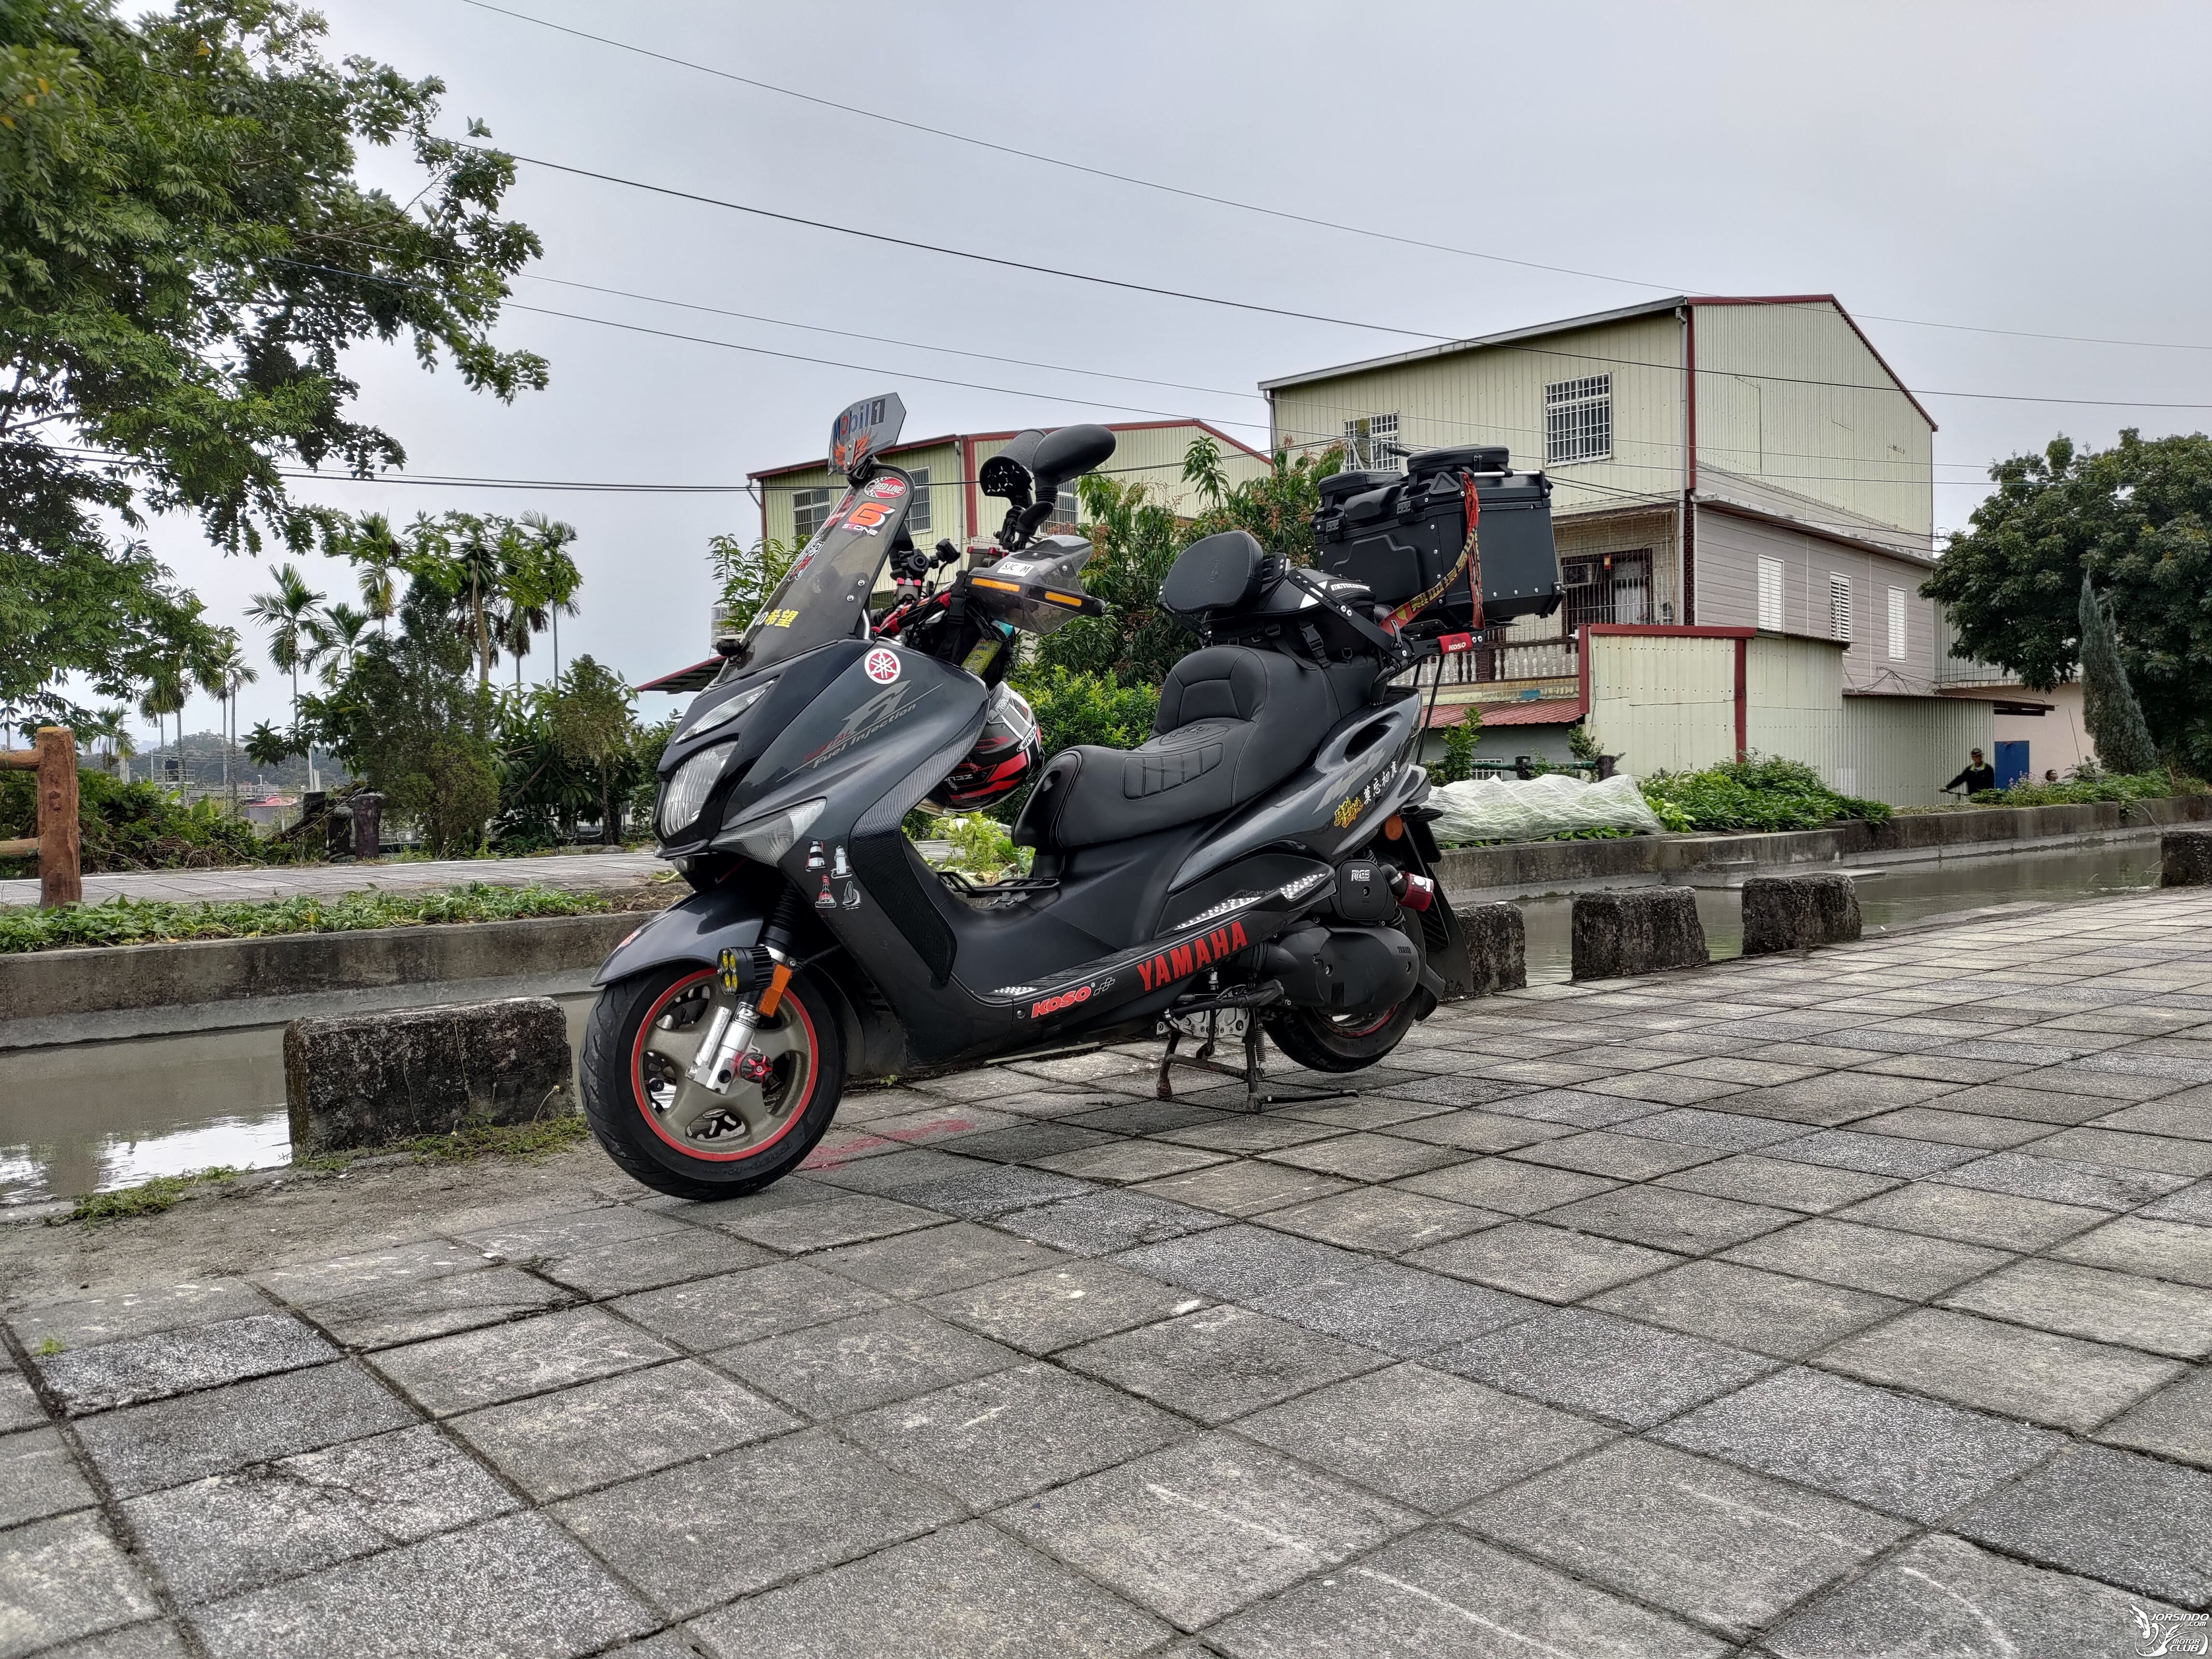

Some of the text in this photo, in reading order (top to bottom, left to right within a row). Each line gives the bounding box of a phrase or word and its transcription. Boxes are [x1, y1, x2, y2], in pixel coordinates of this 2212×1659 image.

[833, 403, 870, 445] Mobil
[887, 484, 904, 494] LINE
[1449, 642, 1466, 651] KOSO
[813, 703, 917, 769] Fuel Injection
[1136, 921, 1248, 991] YAMAHA
[1031, 986, 1091, 1019] KOSO
